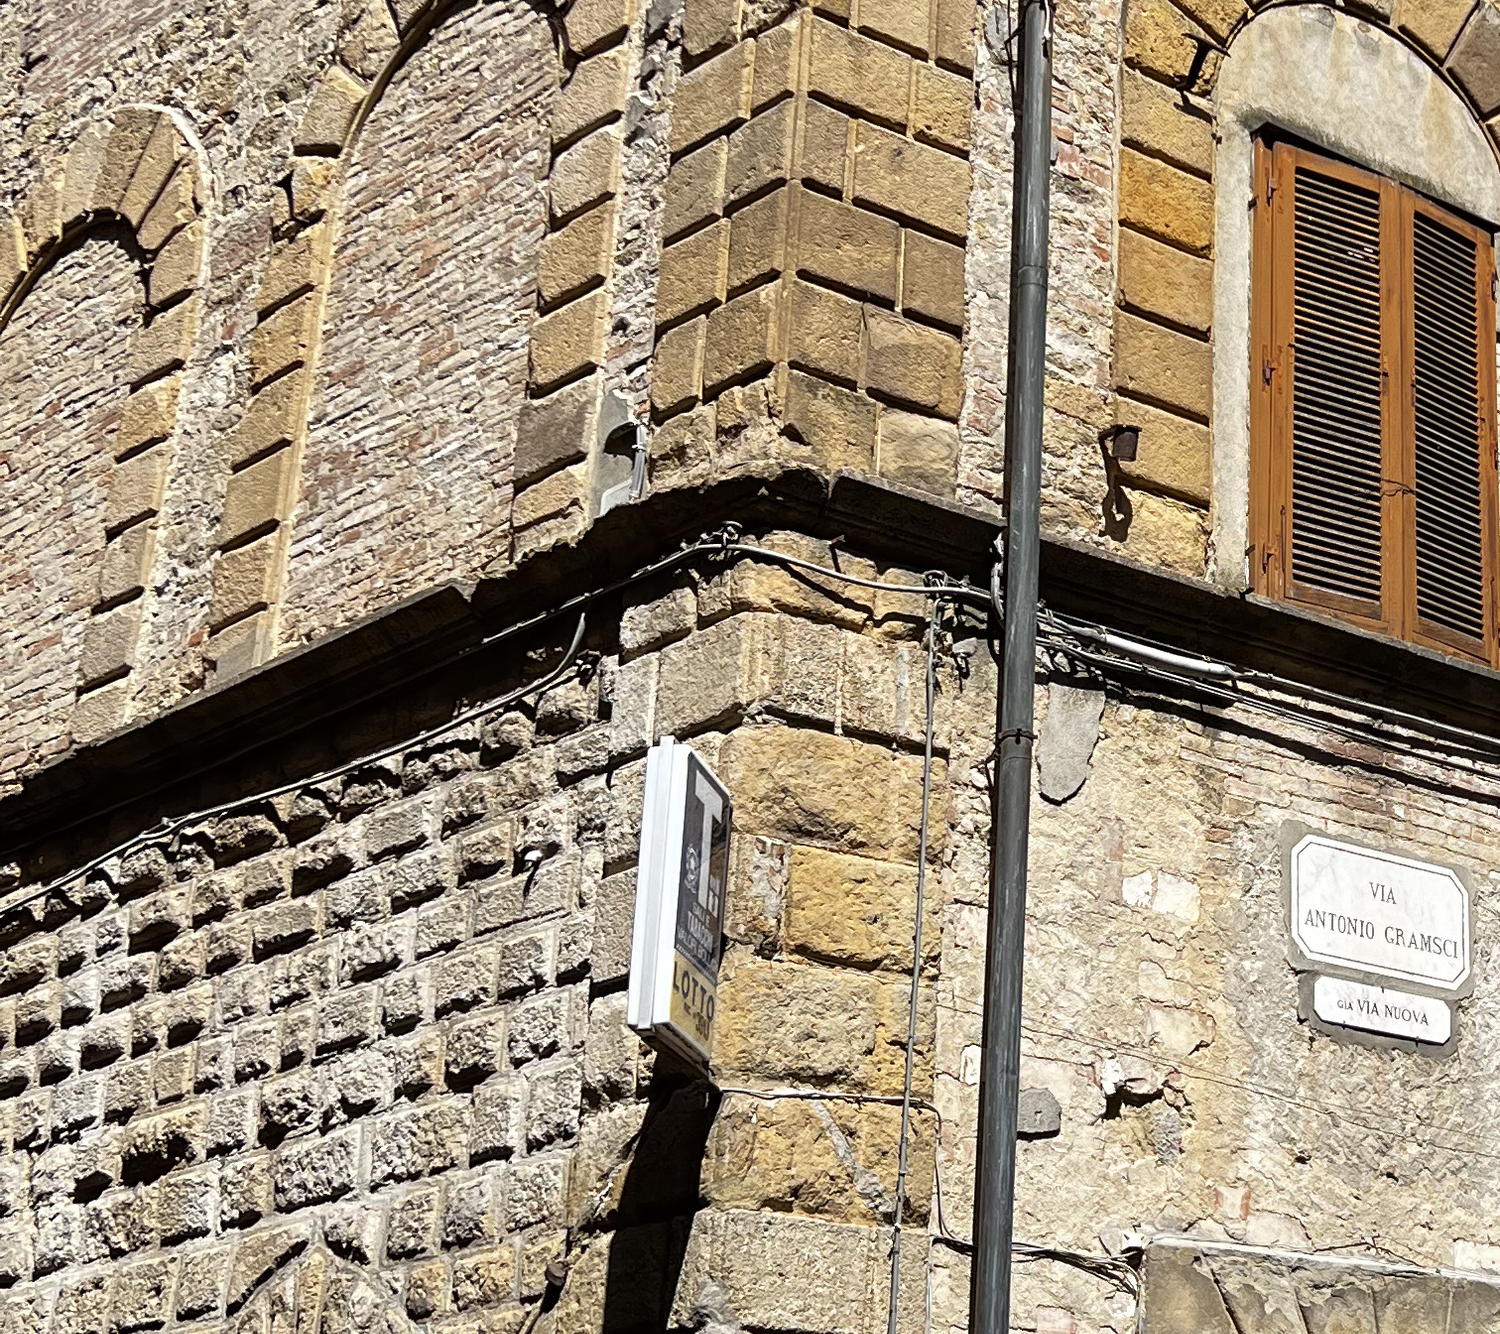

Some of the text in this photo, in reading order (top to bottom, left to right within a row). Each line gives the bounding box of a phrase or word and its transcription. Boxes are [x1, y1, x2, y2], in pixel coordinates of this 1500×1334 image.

[1369, 881, 1397, 905] VIA
[1304, 908, 1459, 959] ANTONIO GRAMSCI
[673, 960, 715, 1023] LOTTO
[1357, 999, 1380, 1016] VIA
[1384, 1004, 1429, 1026] NUOVA
